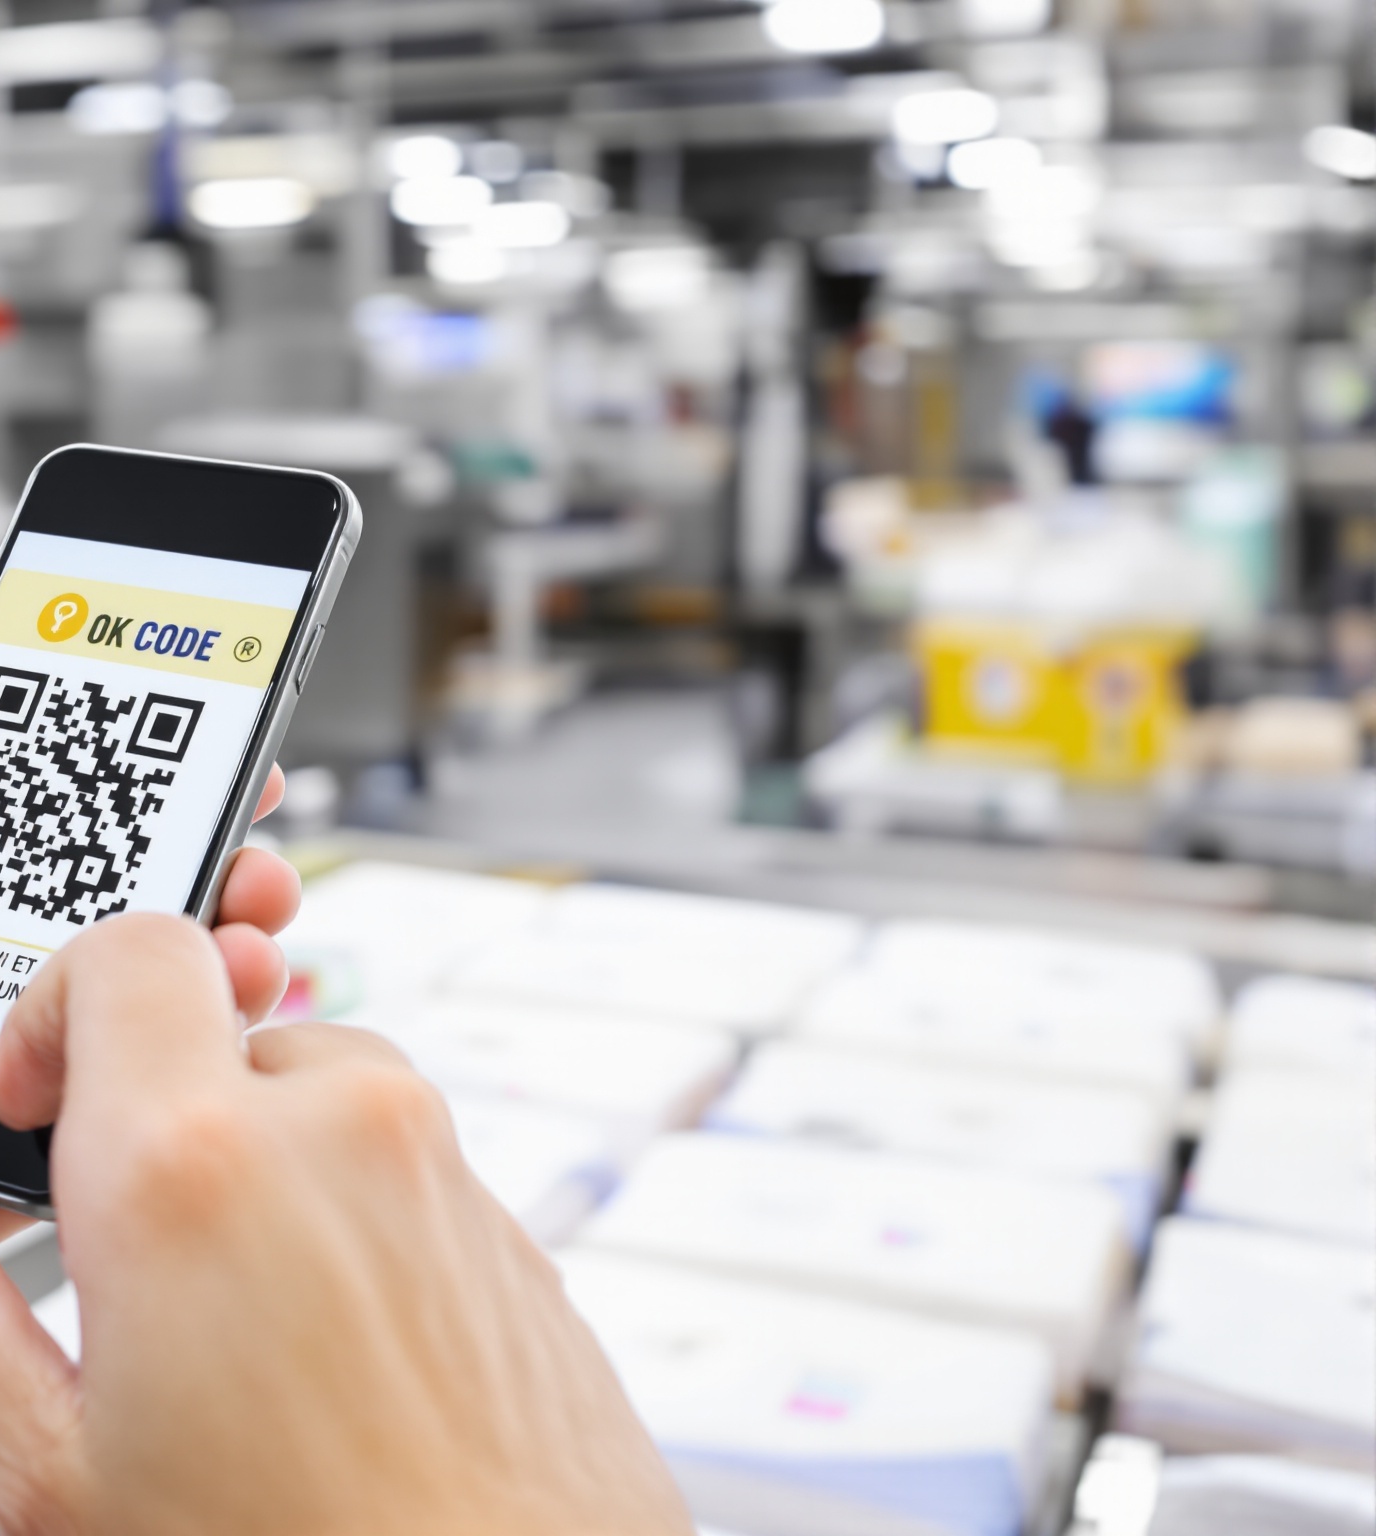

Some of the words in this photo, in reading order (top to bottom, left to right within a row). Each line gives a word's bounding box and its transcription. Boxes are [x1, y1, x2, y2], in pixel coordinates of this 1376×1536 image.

[87, 614, 133, 648] OK
[134, 621, 221, 661] CODE
[11, 955, 37, 974] ET
